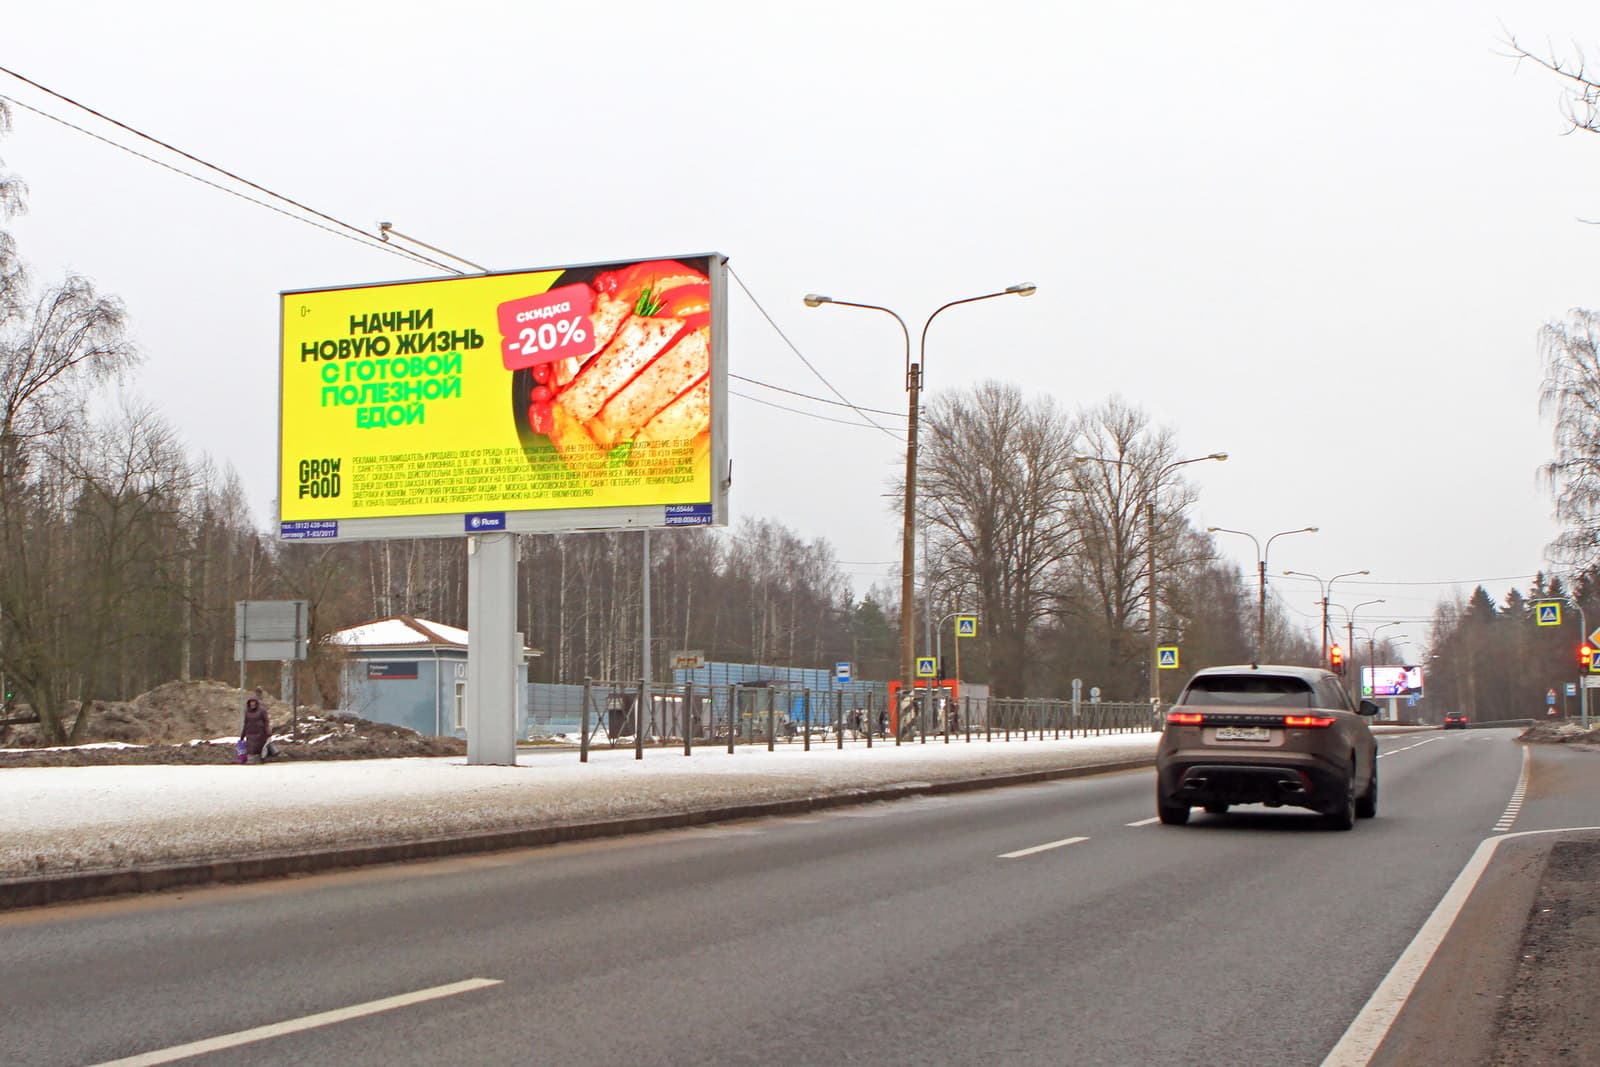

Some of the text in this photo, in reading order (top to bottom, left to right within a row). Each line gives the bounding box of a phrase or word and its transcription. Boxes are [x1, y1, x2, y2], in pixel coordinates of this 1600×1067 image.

[301, 305, 311, 317] 0+
[350, 308, 433, 335] НАЧНИ
[516, 302, 570, 322] скидка
[301, 328, 484, 362] НОВУЮ ЖИЗНЬ
[509, 316, 586, 355] -20%
[322, 352, 462, 383] С ГОТОВОЙ
[321, 375, 461, 407] ПОЛЕЗНОЙ
[356, 402, 425, 429] ЕДОЙ
[299, 458, 341, 483] GROW
[299, 473, 340, 499] FOOD
